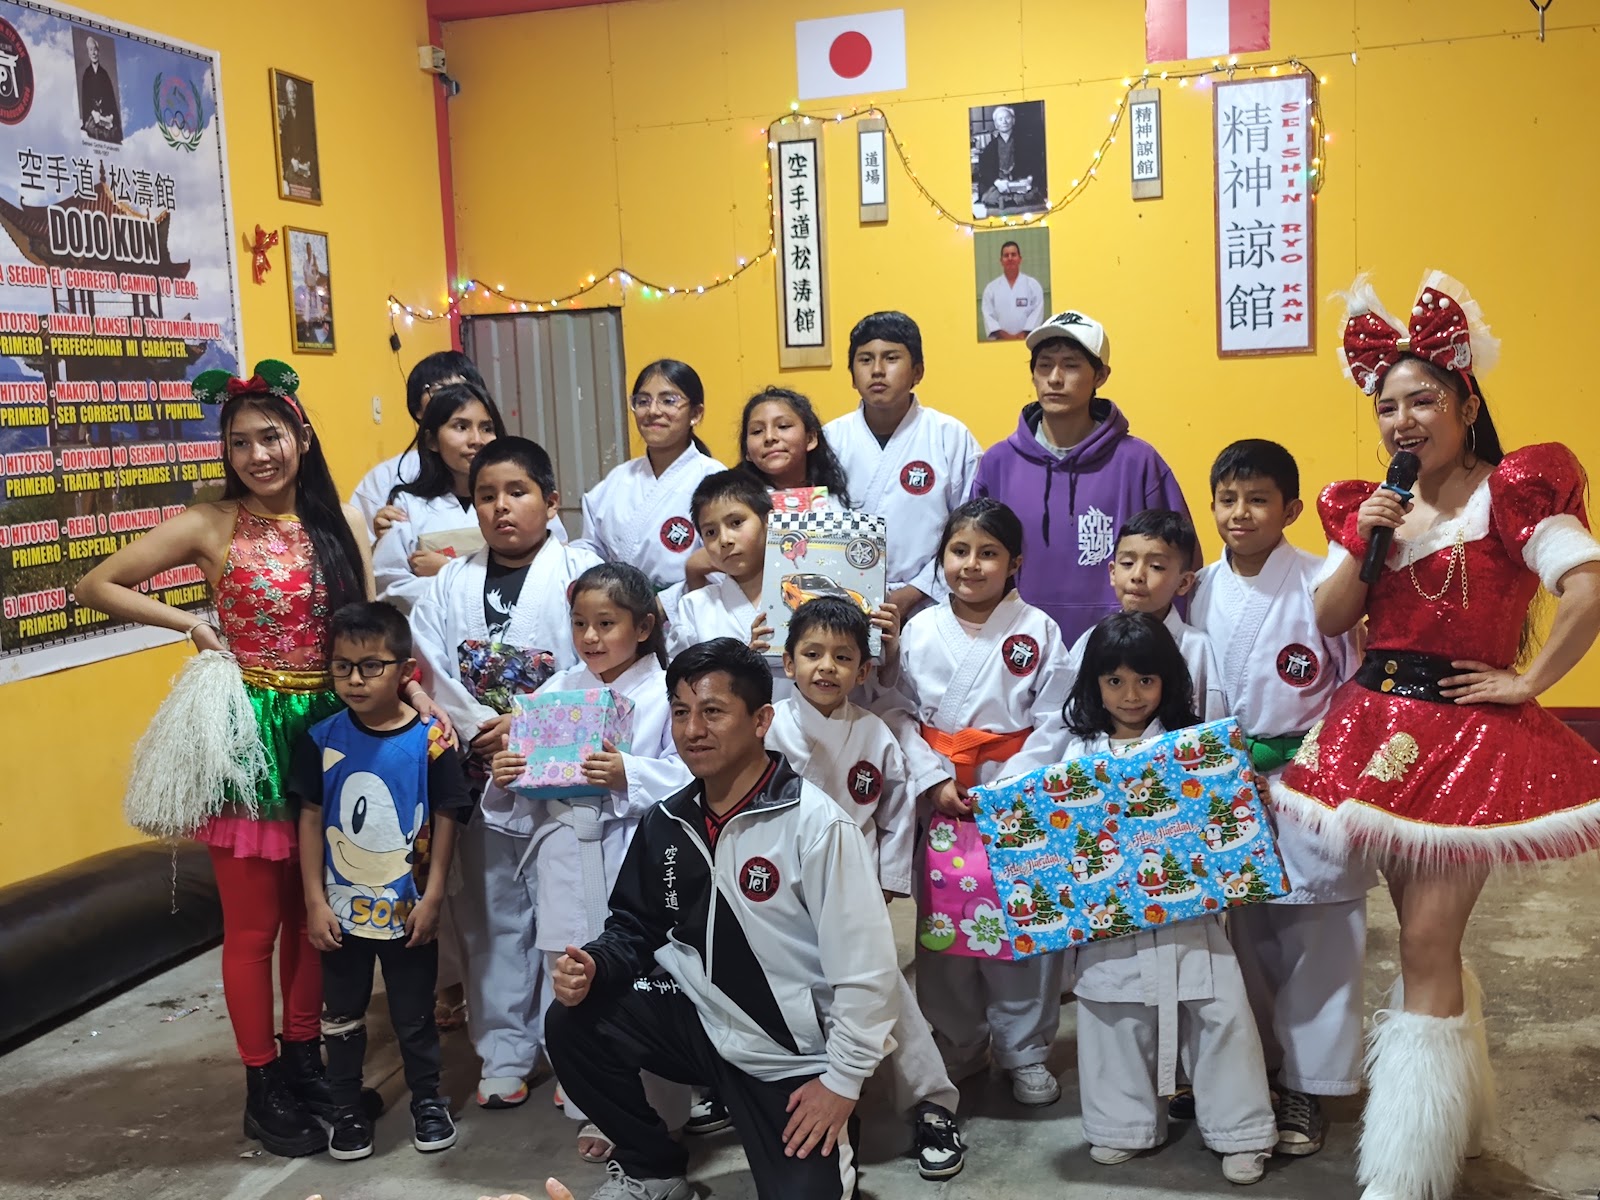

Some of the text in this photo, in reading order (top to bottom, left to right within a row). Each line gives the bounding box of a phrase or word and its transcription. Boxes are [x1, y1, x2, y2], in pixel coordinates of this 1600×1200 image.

[18, 148, 97, 200] 空手道
[865, 151, 880, 185] 道場
[1222, 102, 1276, 332] 精神諒館
[1280, 102, 1303, 323] SEISHIN RYO KAN
[49, 206, 159, 264] DOJO KUN
[8, 265, 47, 286] SEGUIR
[51, 268, 62, 287] EL
[66, 270, 117, 291] CORRECTO
[121, 274, 157, 294] CAMINO
[159, 277, 171, 295] YO
[0, 312, 38, 331] ITOTSU
[49, 314, 91, 333] JINKAKU
[95, 317, 129, 334] KANSEI
[132, 318, 142, 335] NI
[145, 319, 197, 338] TSUTOMURU
[51, 337, 123, 356] PERFECCIONAR
[126, 340, 138, 356] MI
[0, 383, 46, 401] HITOTSU
[57, 383, 98, 400] MAKOTO
[102, 383, 115, 399] NO
[119, 383, 147, 399] MICHI
[150, 383, 157, 400] O
[160, 383, 193, 399] MAMOR
[1, 407, 49, 426] PRIMERO
[57, 406, 76, 424] SER
[156, 404, 162, 420] Y
[7, 453, 52, 473] HITOTSU
[63, 450, 110, 469] DORYOKU
[114, 448, 126, 465] NO
[130, 446, 165, 464] SEISHIN
[168, 445, 175, 462] O
[178, 442, 218, 460] YASHINAU
[6, 476, 55, 498] PRIMERO
[62, 472, 100, 492] TRATAR
[104, 471, 116, 488] DE
[120, 466, 170, 487] SUPERARSE
[173, 466, 178, 481] Y
[182, 464, 198, 480] SER
[201, 462, 226, 479] HONES
[12, 522, 58, 545] HITOTSU
[69, 517, 95, 537] REIGI
[99, 515, 106, 533] O
[110, 509, 160, 532] OMONZURU
[12, 544, 61, 569] PRIMERO
[69, 536, 117, 560] RESPETAR
[5, 598, 17, 617] 5)
[19, 589, 65, 614] HITOTSU
[20, 612, 67, 638] PRIMERO
[663, 844, 680, 911] 空手道
[351, 897, 413, 928] SON
